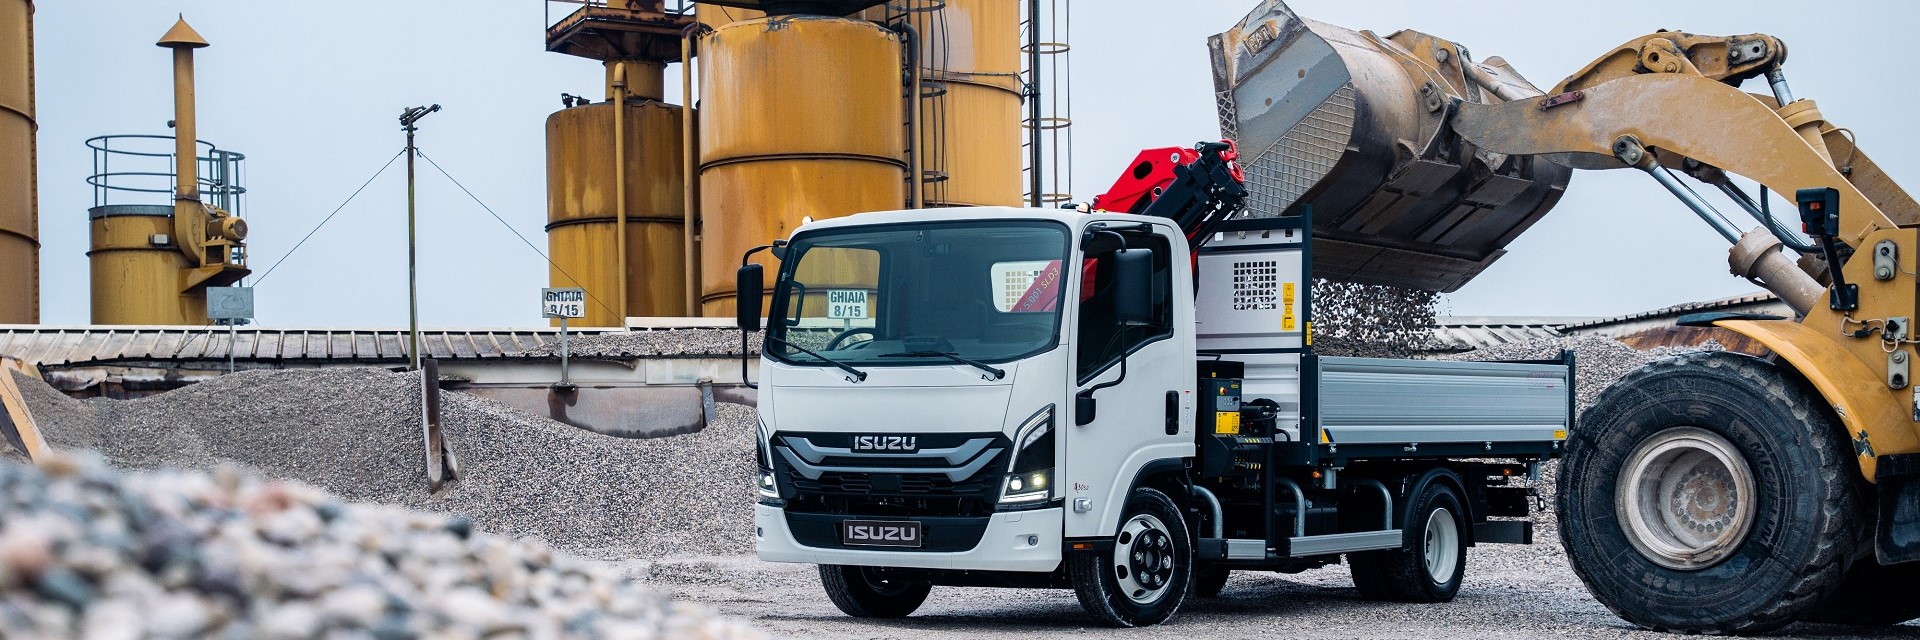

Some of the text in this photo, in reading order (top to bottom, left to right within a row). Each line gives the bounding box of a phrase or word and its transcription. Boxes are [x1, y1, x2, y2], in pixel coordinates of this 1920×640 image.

[1023, 267, 1059, 309] 5.001 SLD3
[546, 291, 583, 302] GHIAIA
[830, 291, 866, 303] GHIAIA
[550, 304, 579, 316] 8/15
[834, 305, 861, 317] 8/15
[854, 435, 916, 450] ISUZU
[848, 525, 916, 541] ISUZU
